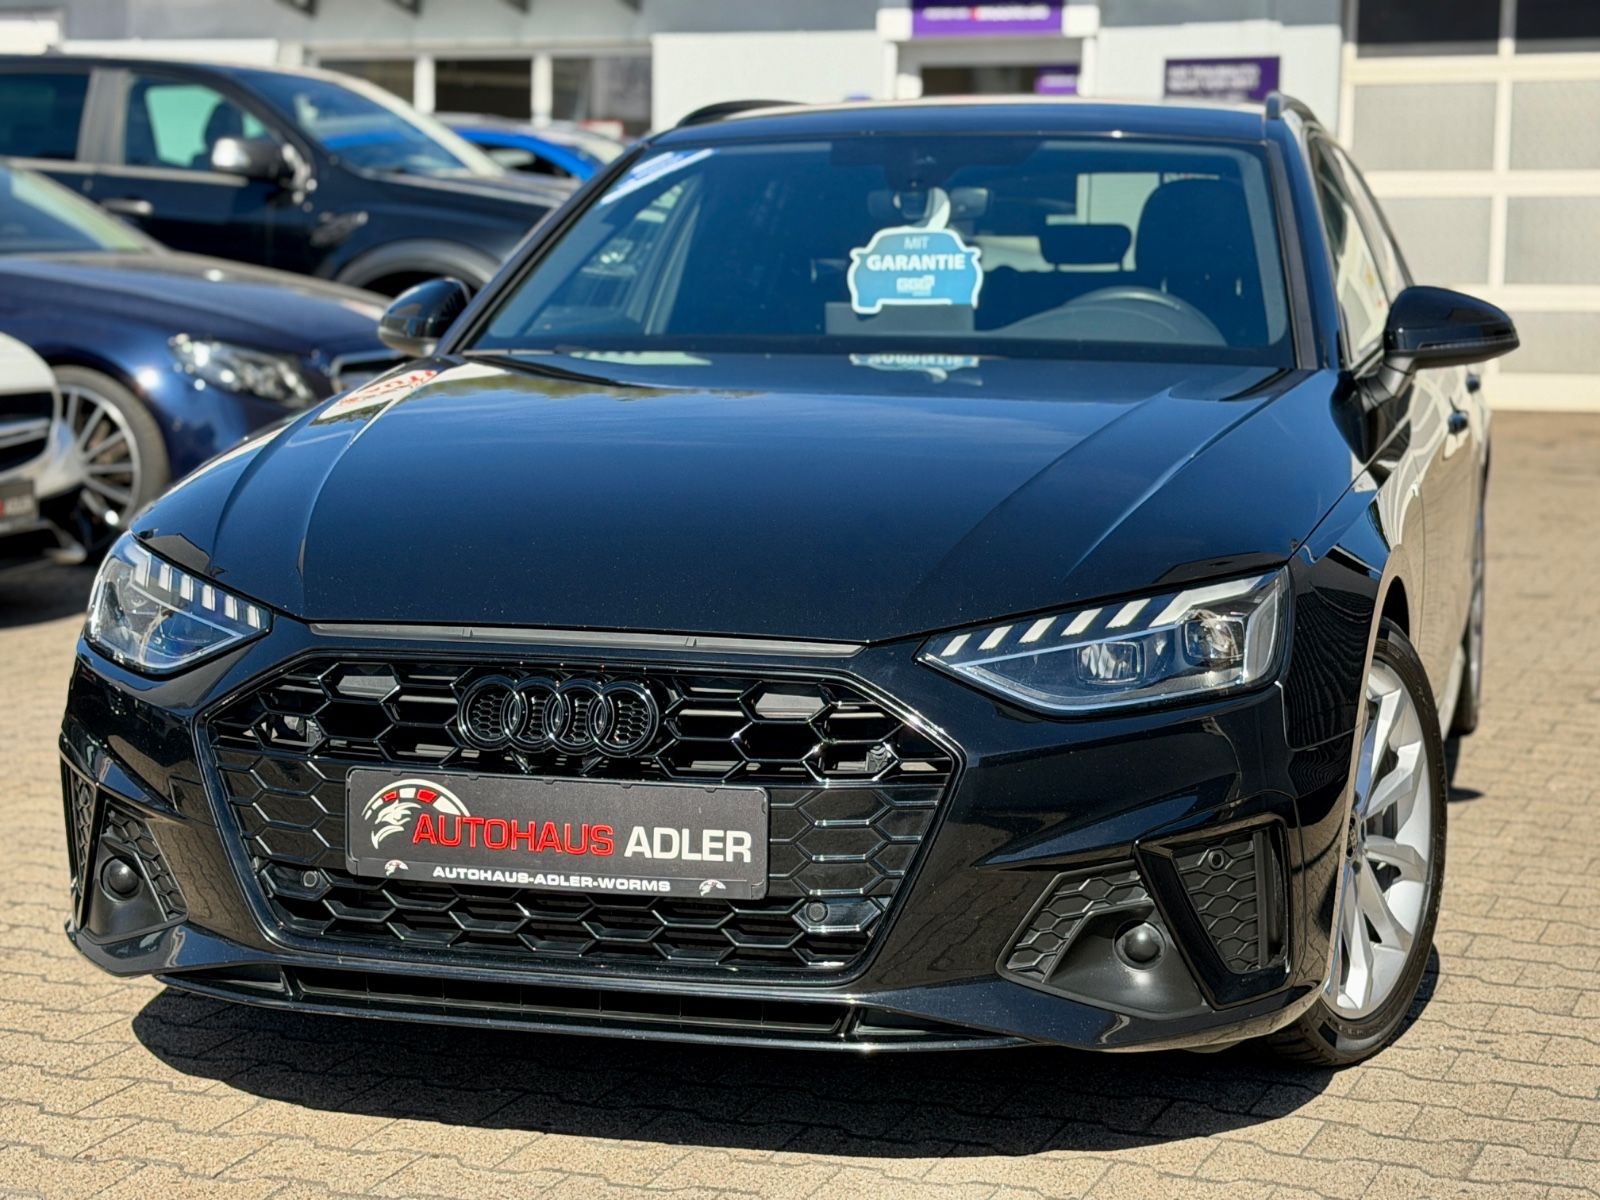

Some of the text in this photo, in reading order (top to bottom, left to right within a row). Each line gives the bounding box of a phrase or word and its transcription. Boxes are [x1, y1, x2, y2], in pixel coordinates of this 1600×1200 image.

[904, 236, 929, 249] MIT
[866, 254, 966, 271] GARANTIE
[412, 813, 752, 863] AUTOHAUS ADLER
[432, 866, 671, 893] AUTOHAUS-ADLER-WORMS
